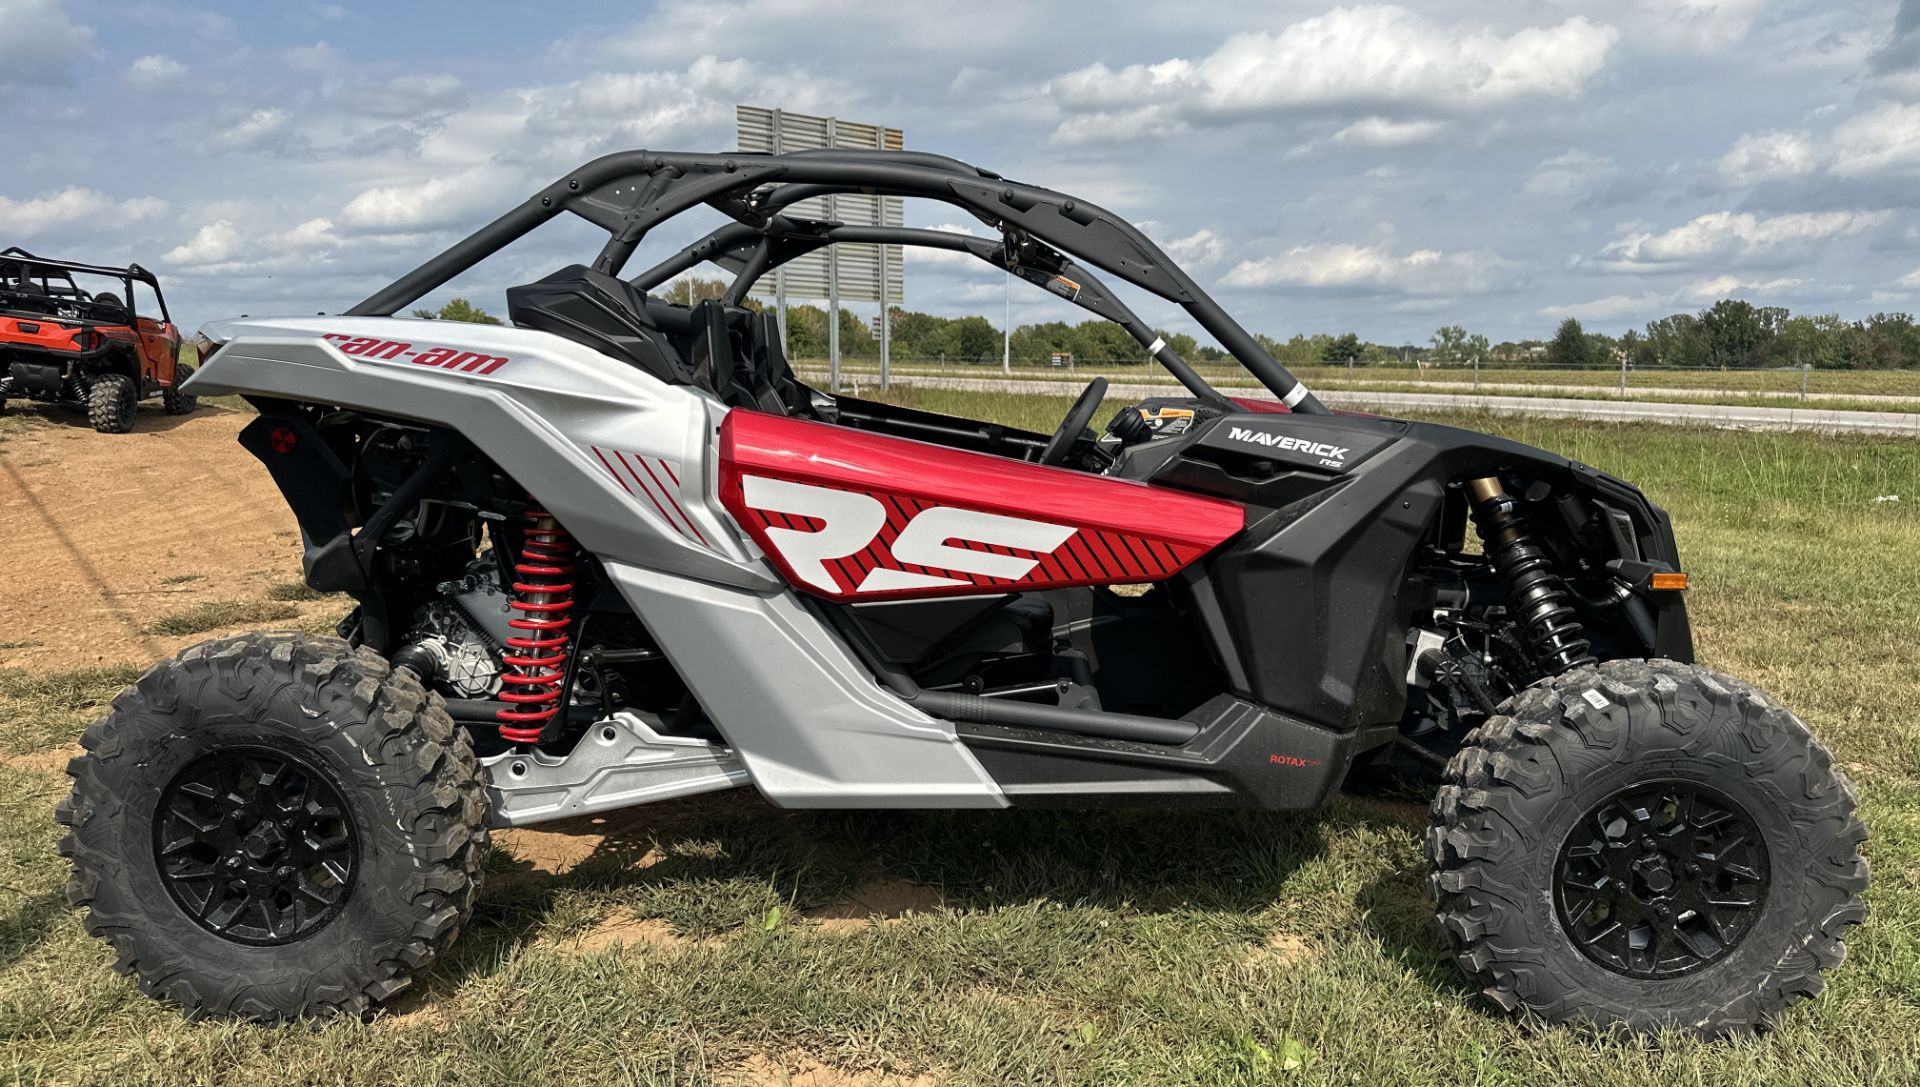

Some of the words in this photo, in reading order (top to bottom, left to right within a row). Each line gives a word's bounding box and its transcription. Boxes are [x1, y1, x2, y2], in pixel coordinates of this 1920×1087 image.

[1228, 427, 1351, 460] MAVERICK
[1319, 458, 1343, 468] RS
[742, 474, 1079, 594] RS
[1270, 754, 1306, 768] ROTAX
